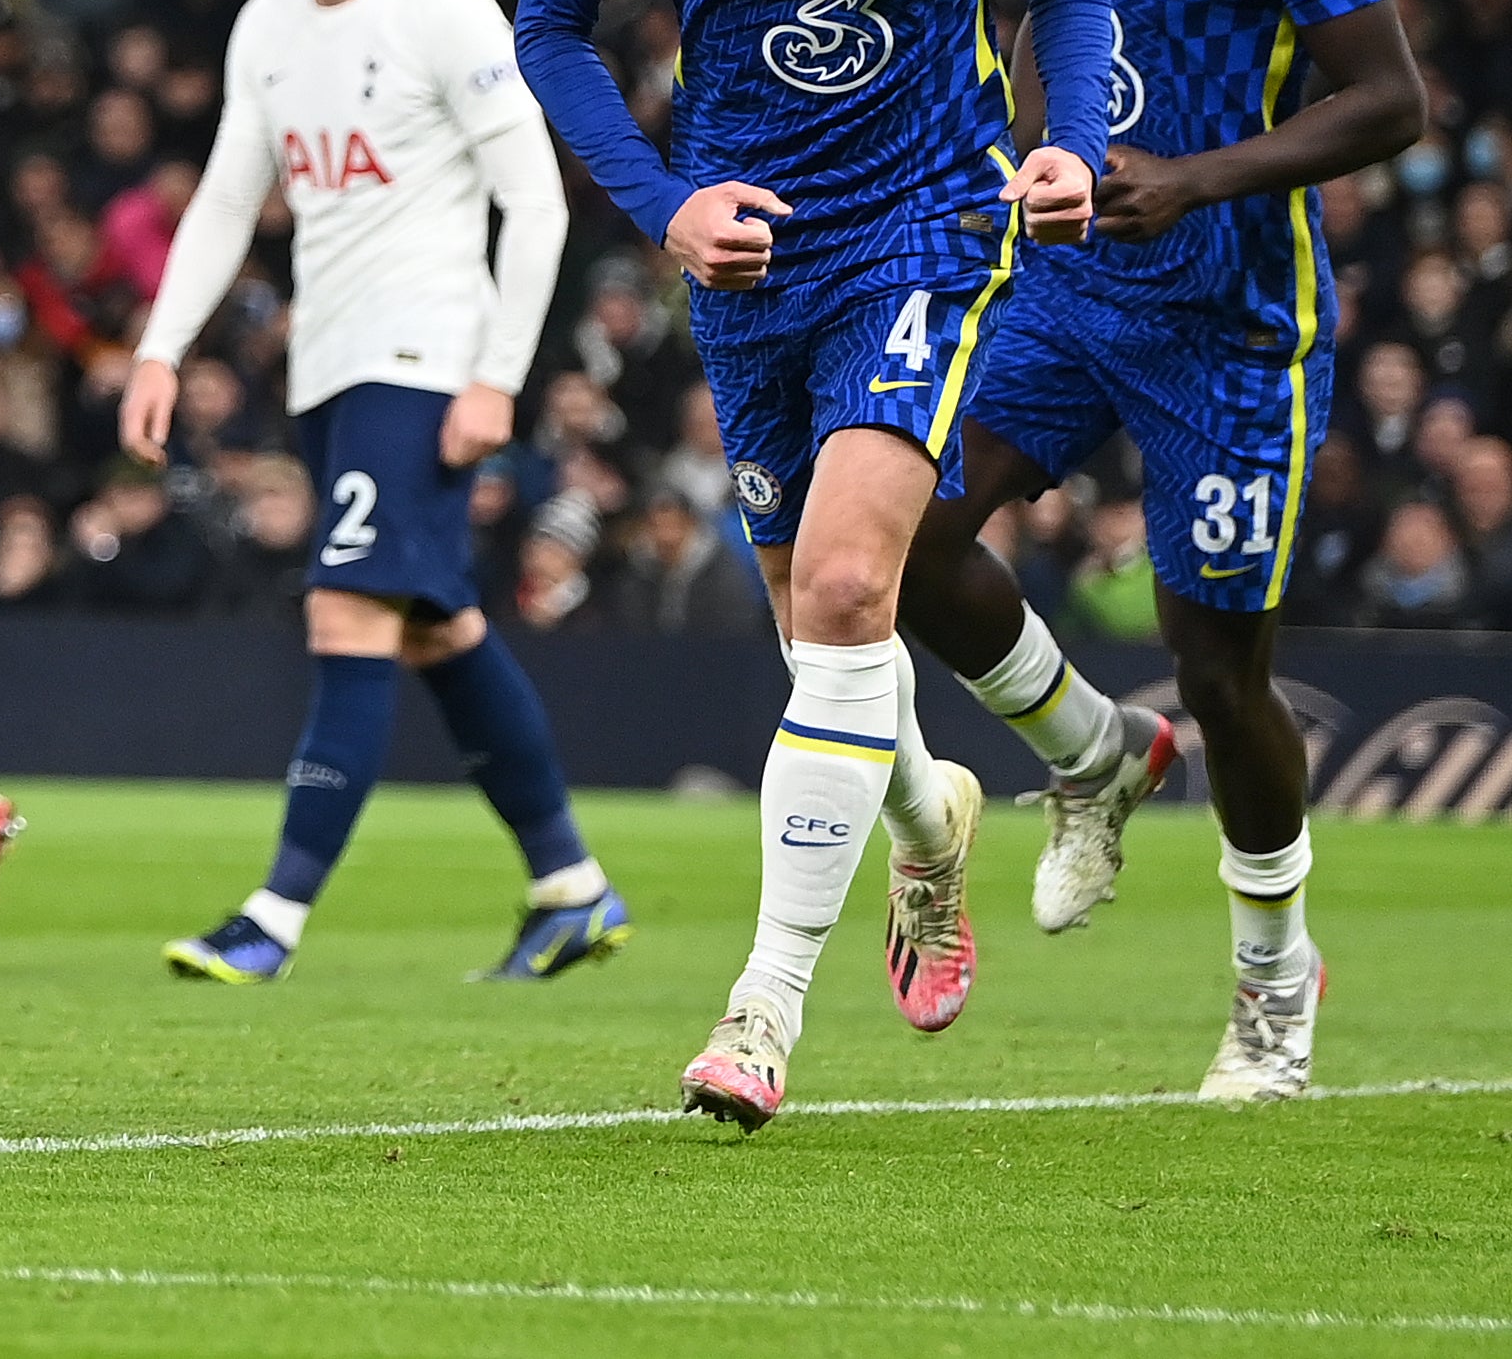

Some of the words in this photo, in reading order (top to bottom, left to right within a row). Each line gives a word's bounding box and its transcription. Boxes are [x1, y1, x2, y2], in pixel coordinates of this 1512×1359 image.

[282, 130, 394, 190] AIA
[885, 290, 932, 372] 4
[332, 470, 378, 546] 2
[1190, 472, 1275, 556] 31
[786, 814, 850, 837] CFC
